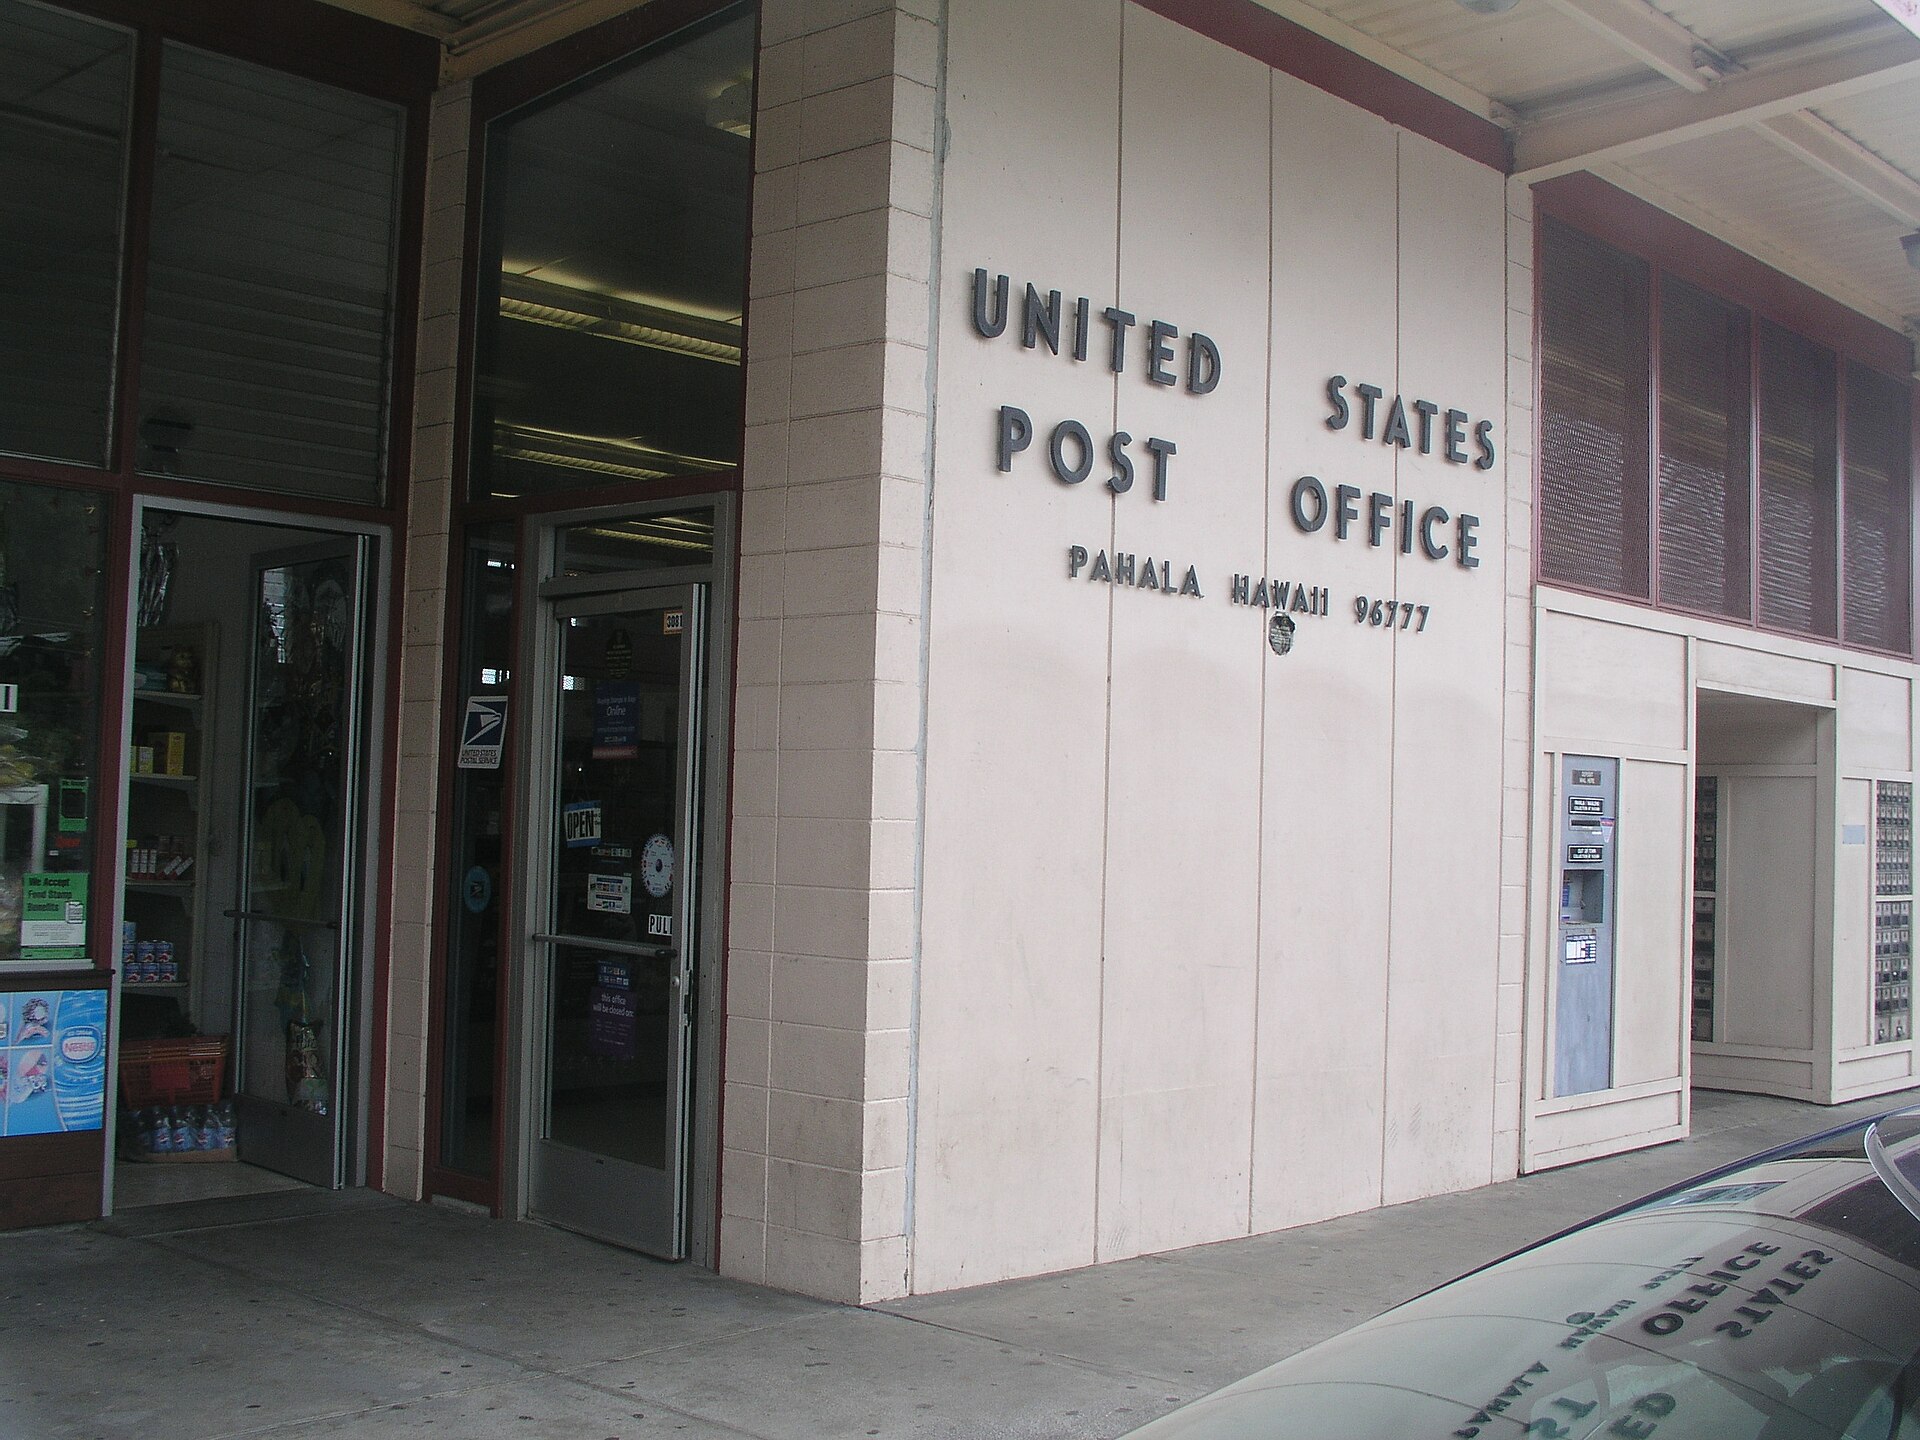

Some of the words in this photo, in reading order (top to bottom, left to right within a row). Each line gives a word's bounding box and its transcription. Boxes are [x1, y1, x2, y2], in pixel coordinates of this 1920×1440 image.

[968, 267, 1221, 395] UNITED
[1326, 375, 1495, 471] STATES
[997, 405, 1177, 502] POST
[1291, 475, 1480, 568] OFFICE
[1069, 544, 1204, 598] PAHALA
[1232, 573, 1329, 616] HAWAII
[1354, 595, 1431, 633] 96777
[461, 749, 479, 757] UNITED
[480, 749, 497, 757] STATES
[567, 810, 594, 840] OPEN
